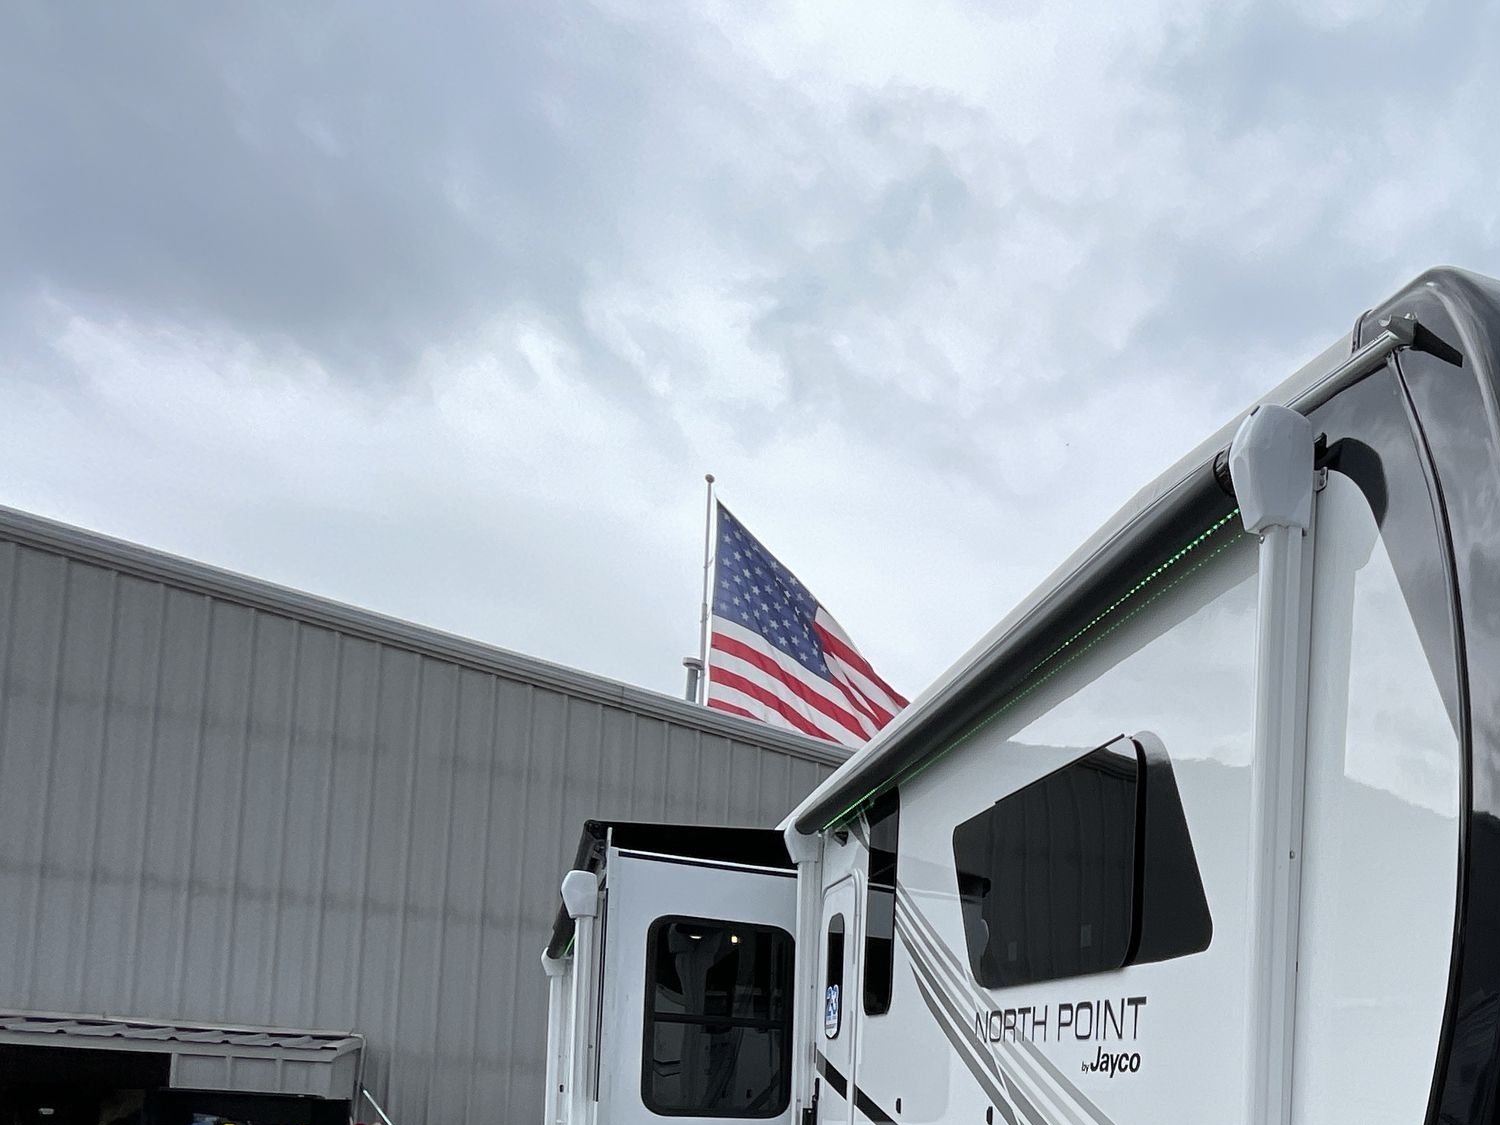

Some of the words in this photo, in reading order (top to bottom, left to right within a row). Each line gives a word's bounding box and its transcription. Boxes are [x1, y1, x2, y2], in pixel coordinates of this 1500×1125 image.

[975, 1005, 1048, 1044] NORTH
[1057, 996, 1147, 1043] POINT
[1081, 1061, 1090, 1075] by
[1090, 1046, 1141, 1078] Jayco
